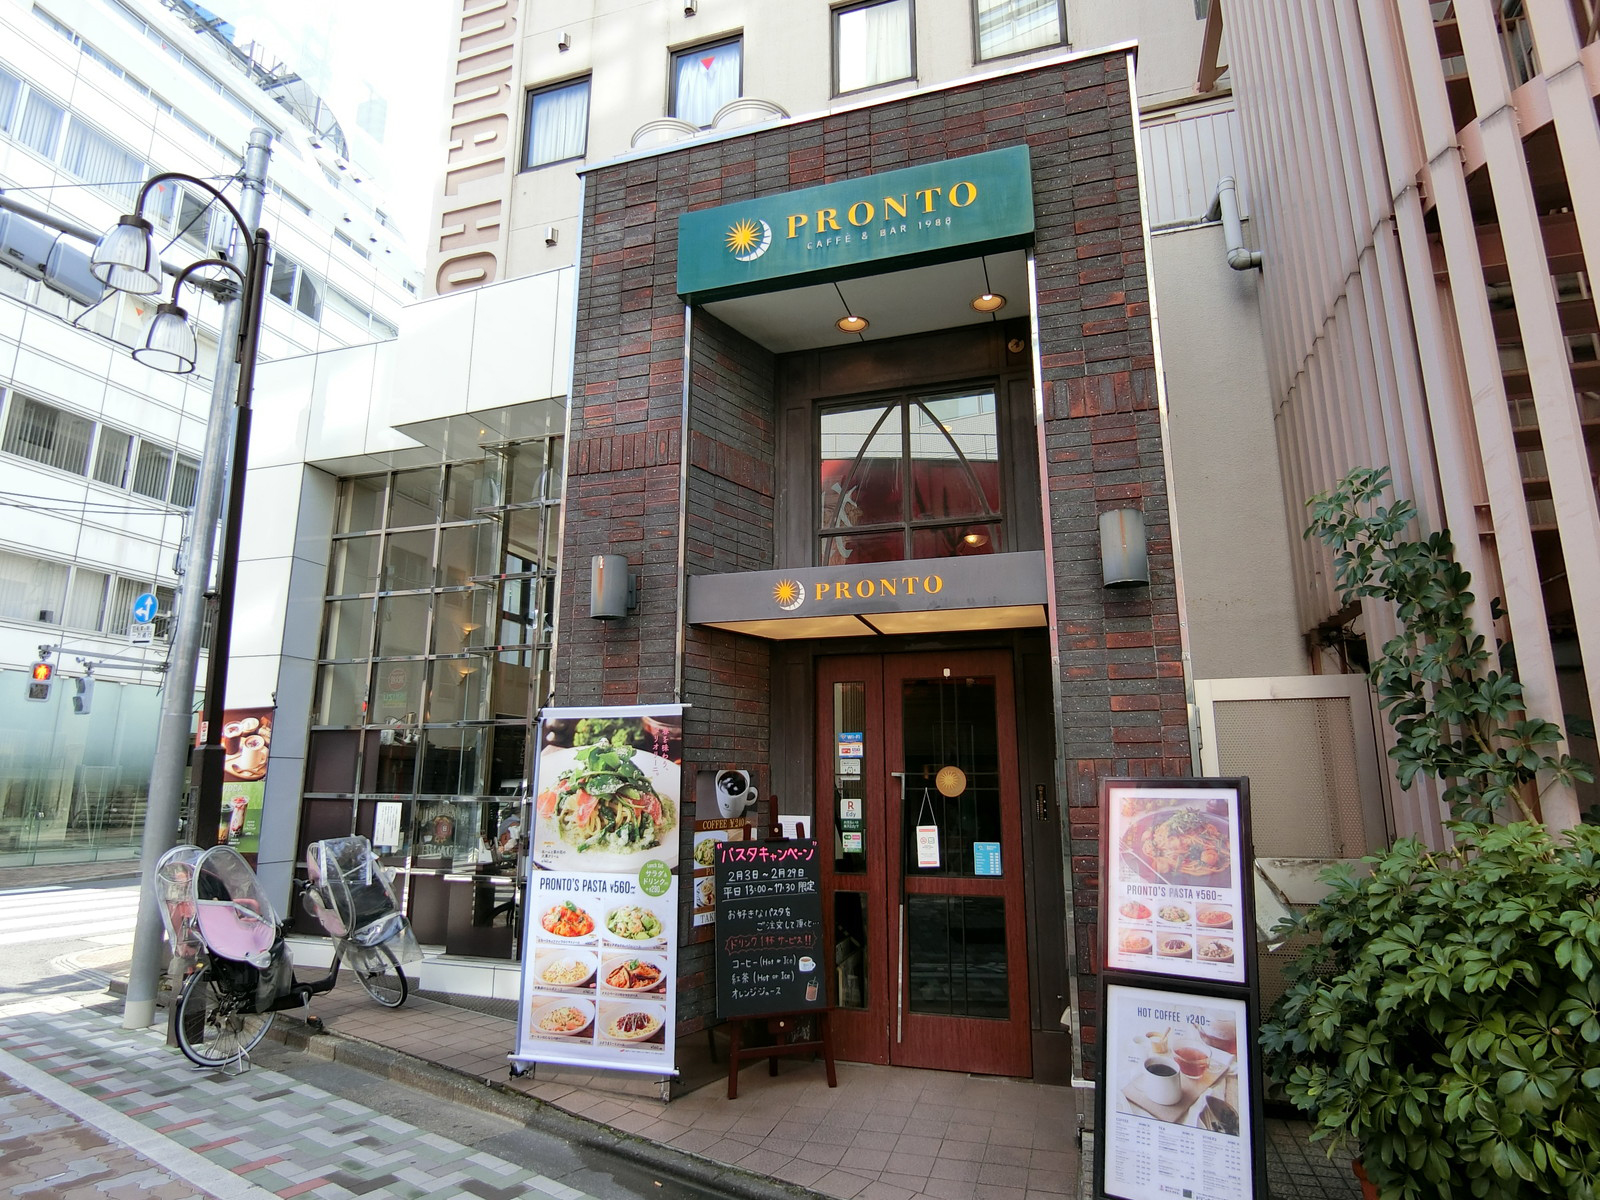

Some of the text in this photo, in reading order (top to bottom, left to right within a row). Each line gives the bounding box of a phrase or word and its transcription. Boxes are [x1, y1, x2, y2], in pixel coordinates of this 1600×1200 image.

[786, 181, 978, 240] PRONTO
[861, 230, 869, 241] &
[879, 224, 908, 238] BAR
[918, 216, 953, 230] 1988
[815, 574, 944, 601] PRONTO
[702, 819, 728, 830] COFFEE
[539, 877, 580, 892] PRONTO'S
[582, 879, 607, 893] PASTA
[1126, 884, 1166, 897] PRONTO'S
[1169, 887, 1194, 899] PASTA
[700, 912, 716, 924] TAK
[727, 906, 791, 920] お好きなパスタを
[731, 972, 749, 985] 紅茶
[1137, 1006, 1152, 1018] HOT
[1154, 1009, 1181, 1023] COFFEE
